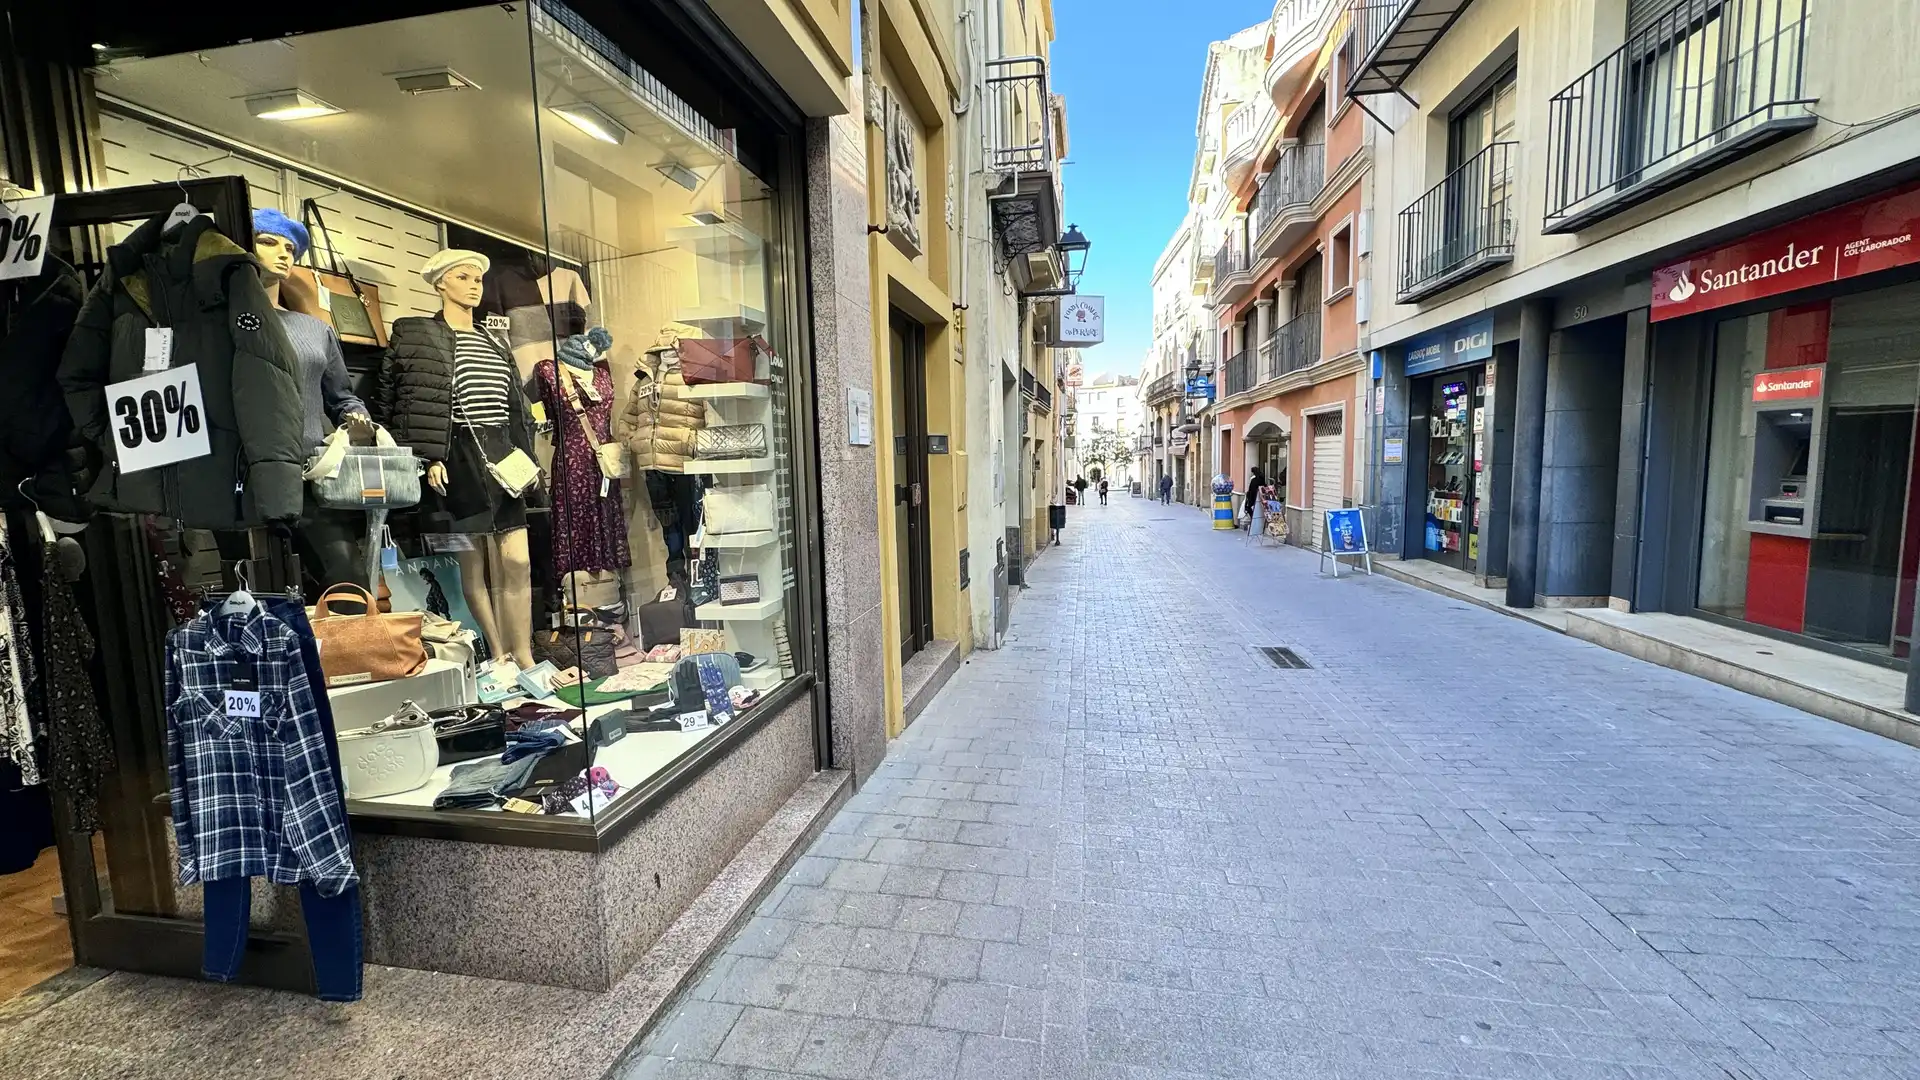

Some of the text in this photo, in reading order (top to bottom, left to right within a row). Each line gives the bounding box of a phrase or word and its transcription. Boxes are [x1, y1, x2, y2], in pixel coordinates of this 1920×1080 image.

[1844, 238, 1870, 251] AGENT
[1700, 243, 1823, 294] Santander
[1573, 305, 1588, 319] 50
[487, 318, 508, 328] 20%
[1454, 332, 1488, 354] DIGI
[770, 374, 785, 384] ONLY
[1767, 379, 1813, 392] Santander
[115, 381, 200, 449] 30%
[395, 557, 461, 577] ANDAM
[484, 684, 496, 693] 19
[228, 696, 256, 713] 20%
[683, 715, 696, 729] 29
[581, 800, 589, 812] 4
